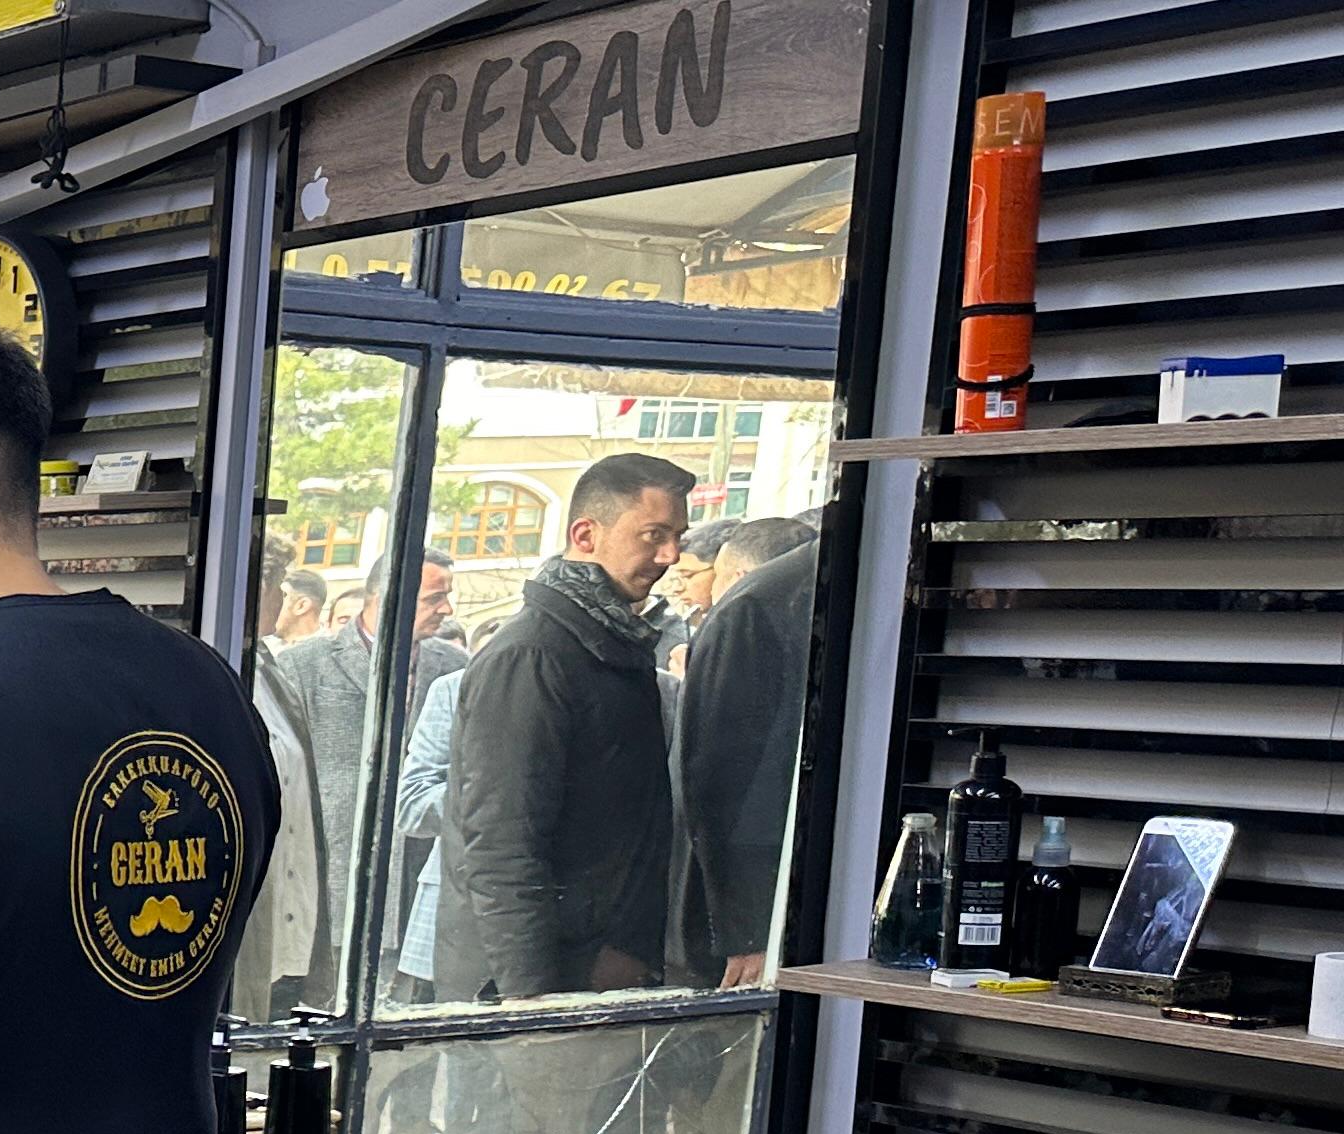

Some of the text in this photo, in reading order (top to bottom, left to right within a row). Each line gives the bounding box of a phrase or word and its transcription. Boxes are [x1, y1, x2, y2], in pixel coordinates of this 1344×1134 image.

[407, 0, 730, 184] CERAN
[12, 265, 19, 294] 1
[23, 293, 38, 323] 2
[110, 837, 207, 887] CERAN
